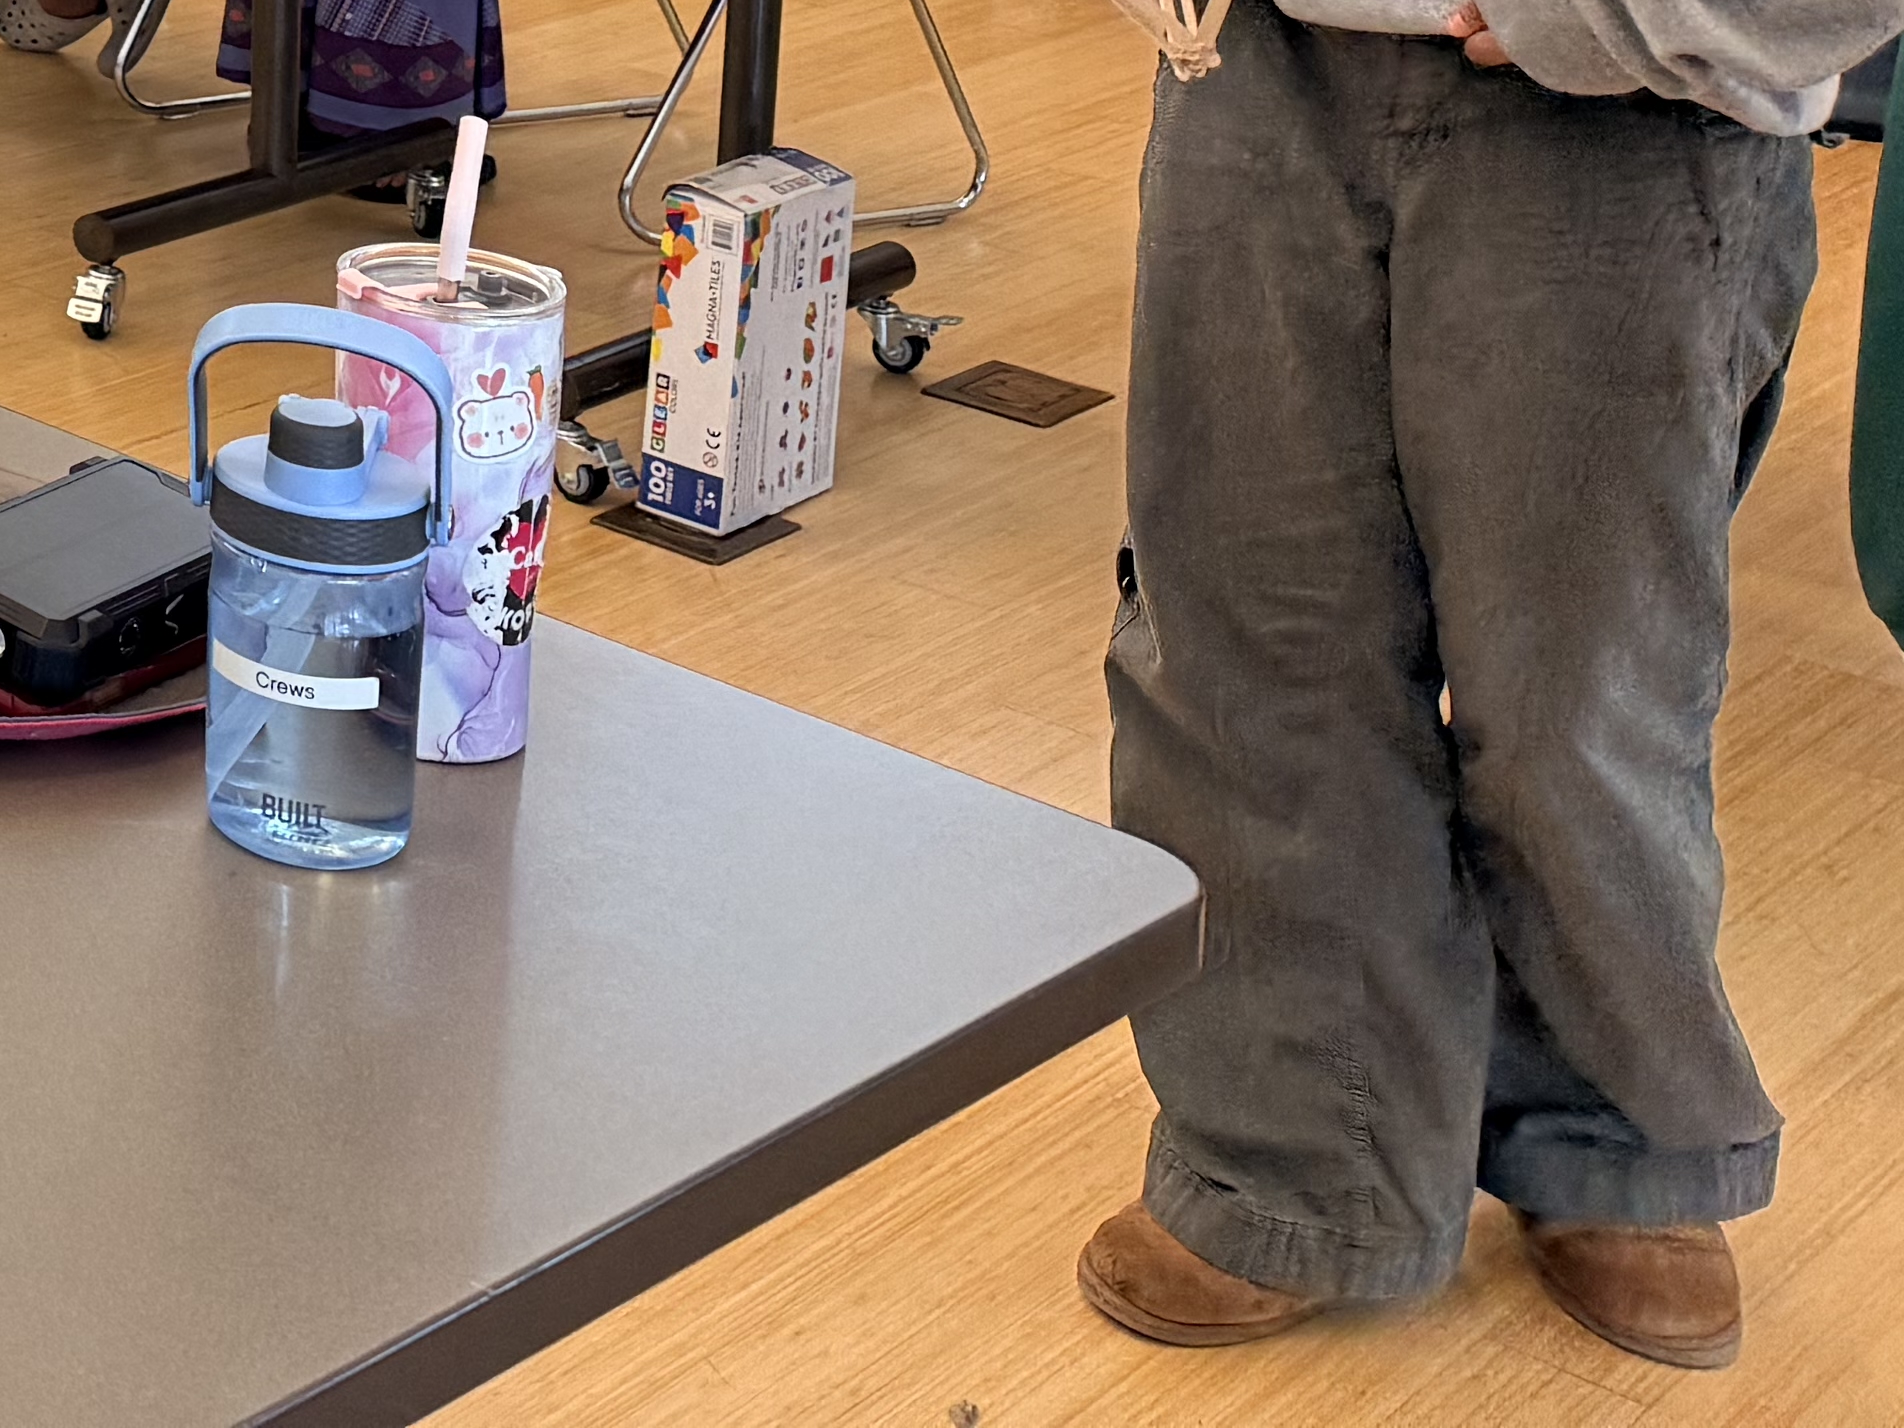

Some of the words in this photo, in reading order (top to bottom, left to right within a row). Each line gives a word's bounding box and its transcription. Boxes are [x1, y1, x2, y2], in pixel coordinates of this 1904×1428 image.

[650, 371, 671, 453] CLEAR
[646, 460, 667, 504] 100
[256, 671, 315, 700] Crews
[262, 793, 327, 828] BUILT
